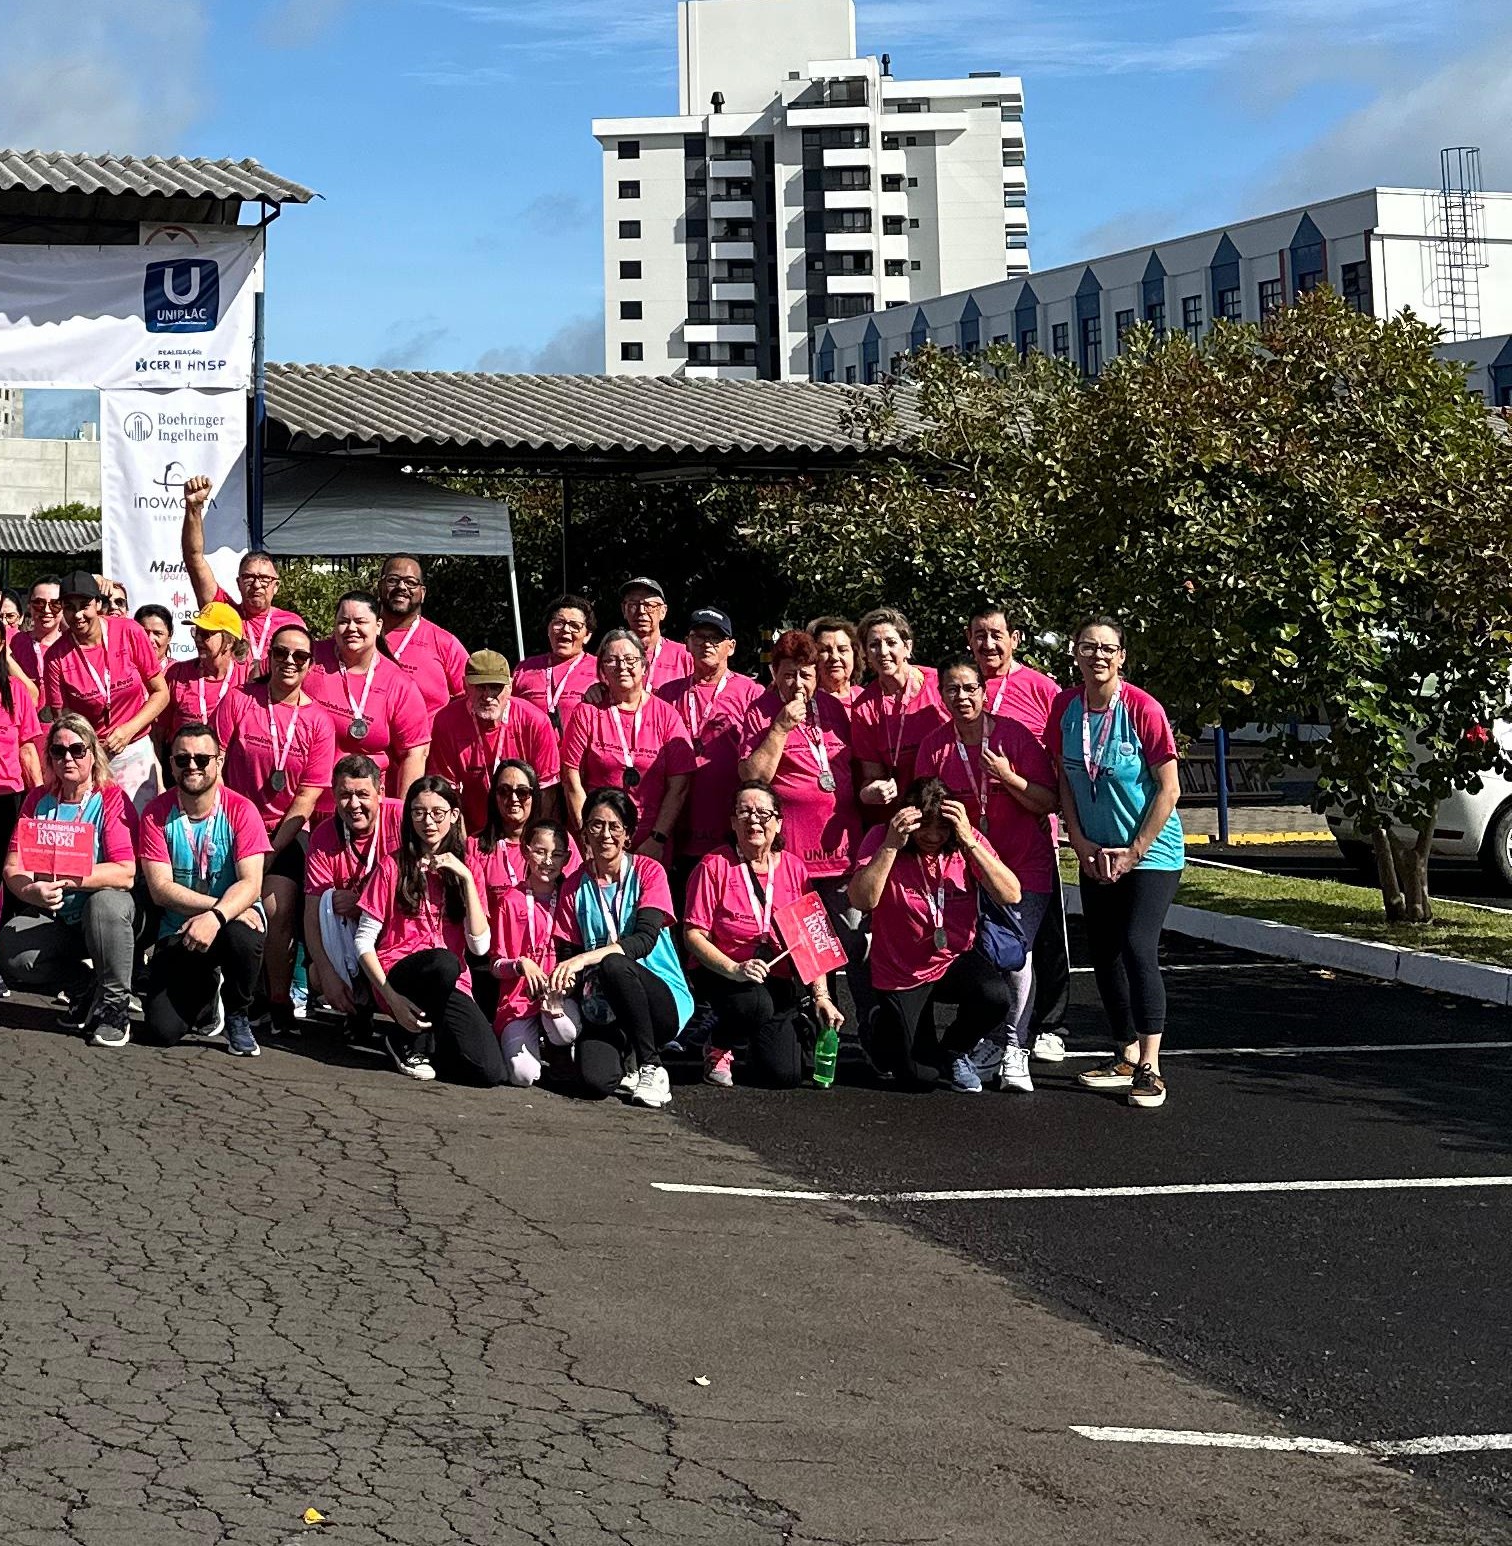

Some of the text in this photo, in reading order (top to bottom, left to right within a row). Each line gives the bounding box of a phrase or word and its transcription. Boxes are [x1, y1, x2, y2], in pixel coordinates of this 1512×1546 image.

[157, 308, 207, 320] UNIPLAC
[149, 361, 170, 370] CER
[188, 360, 227, 371] HNSP
[158, 412, 225, 428] Boehringer
[158, 429, 219, 443] Ingelheim
[37, 822, 86, 834] CAMINHADA
